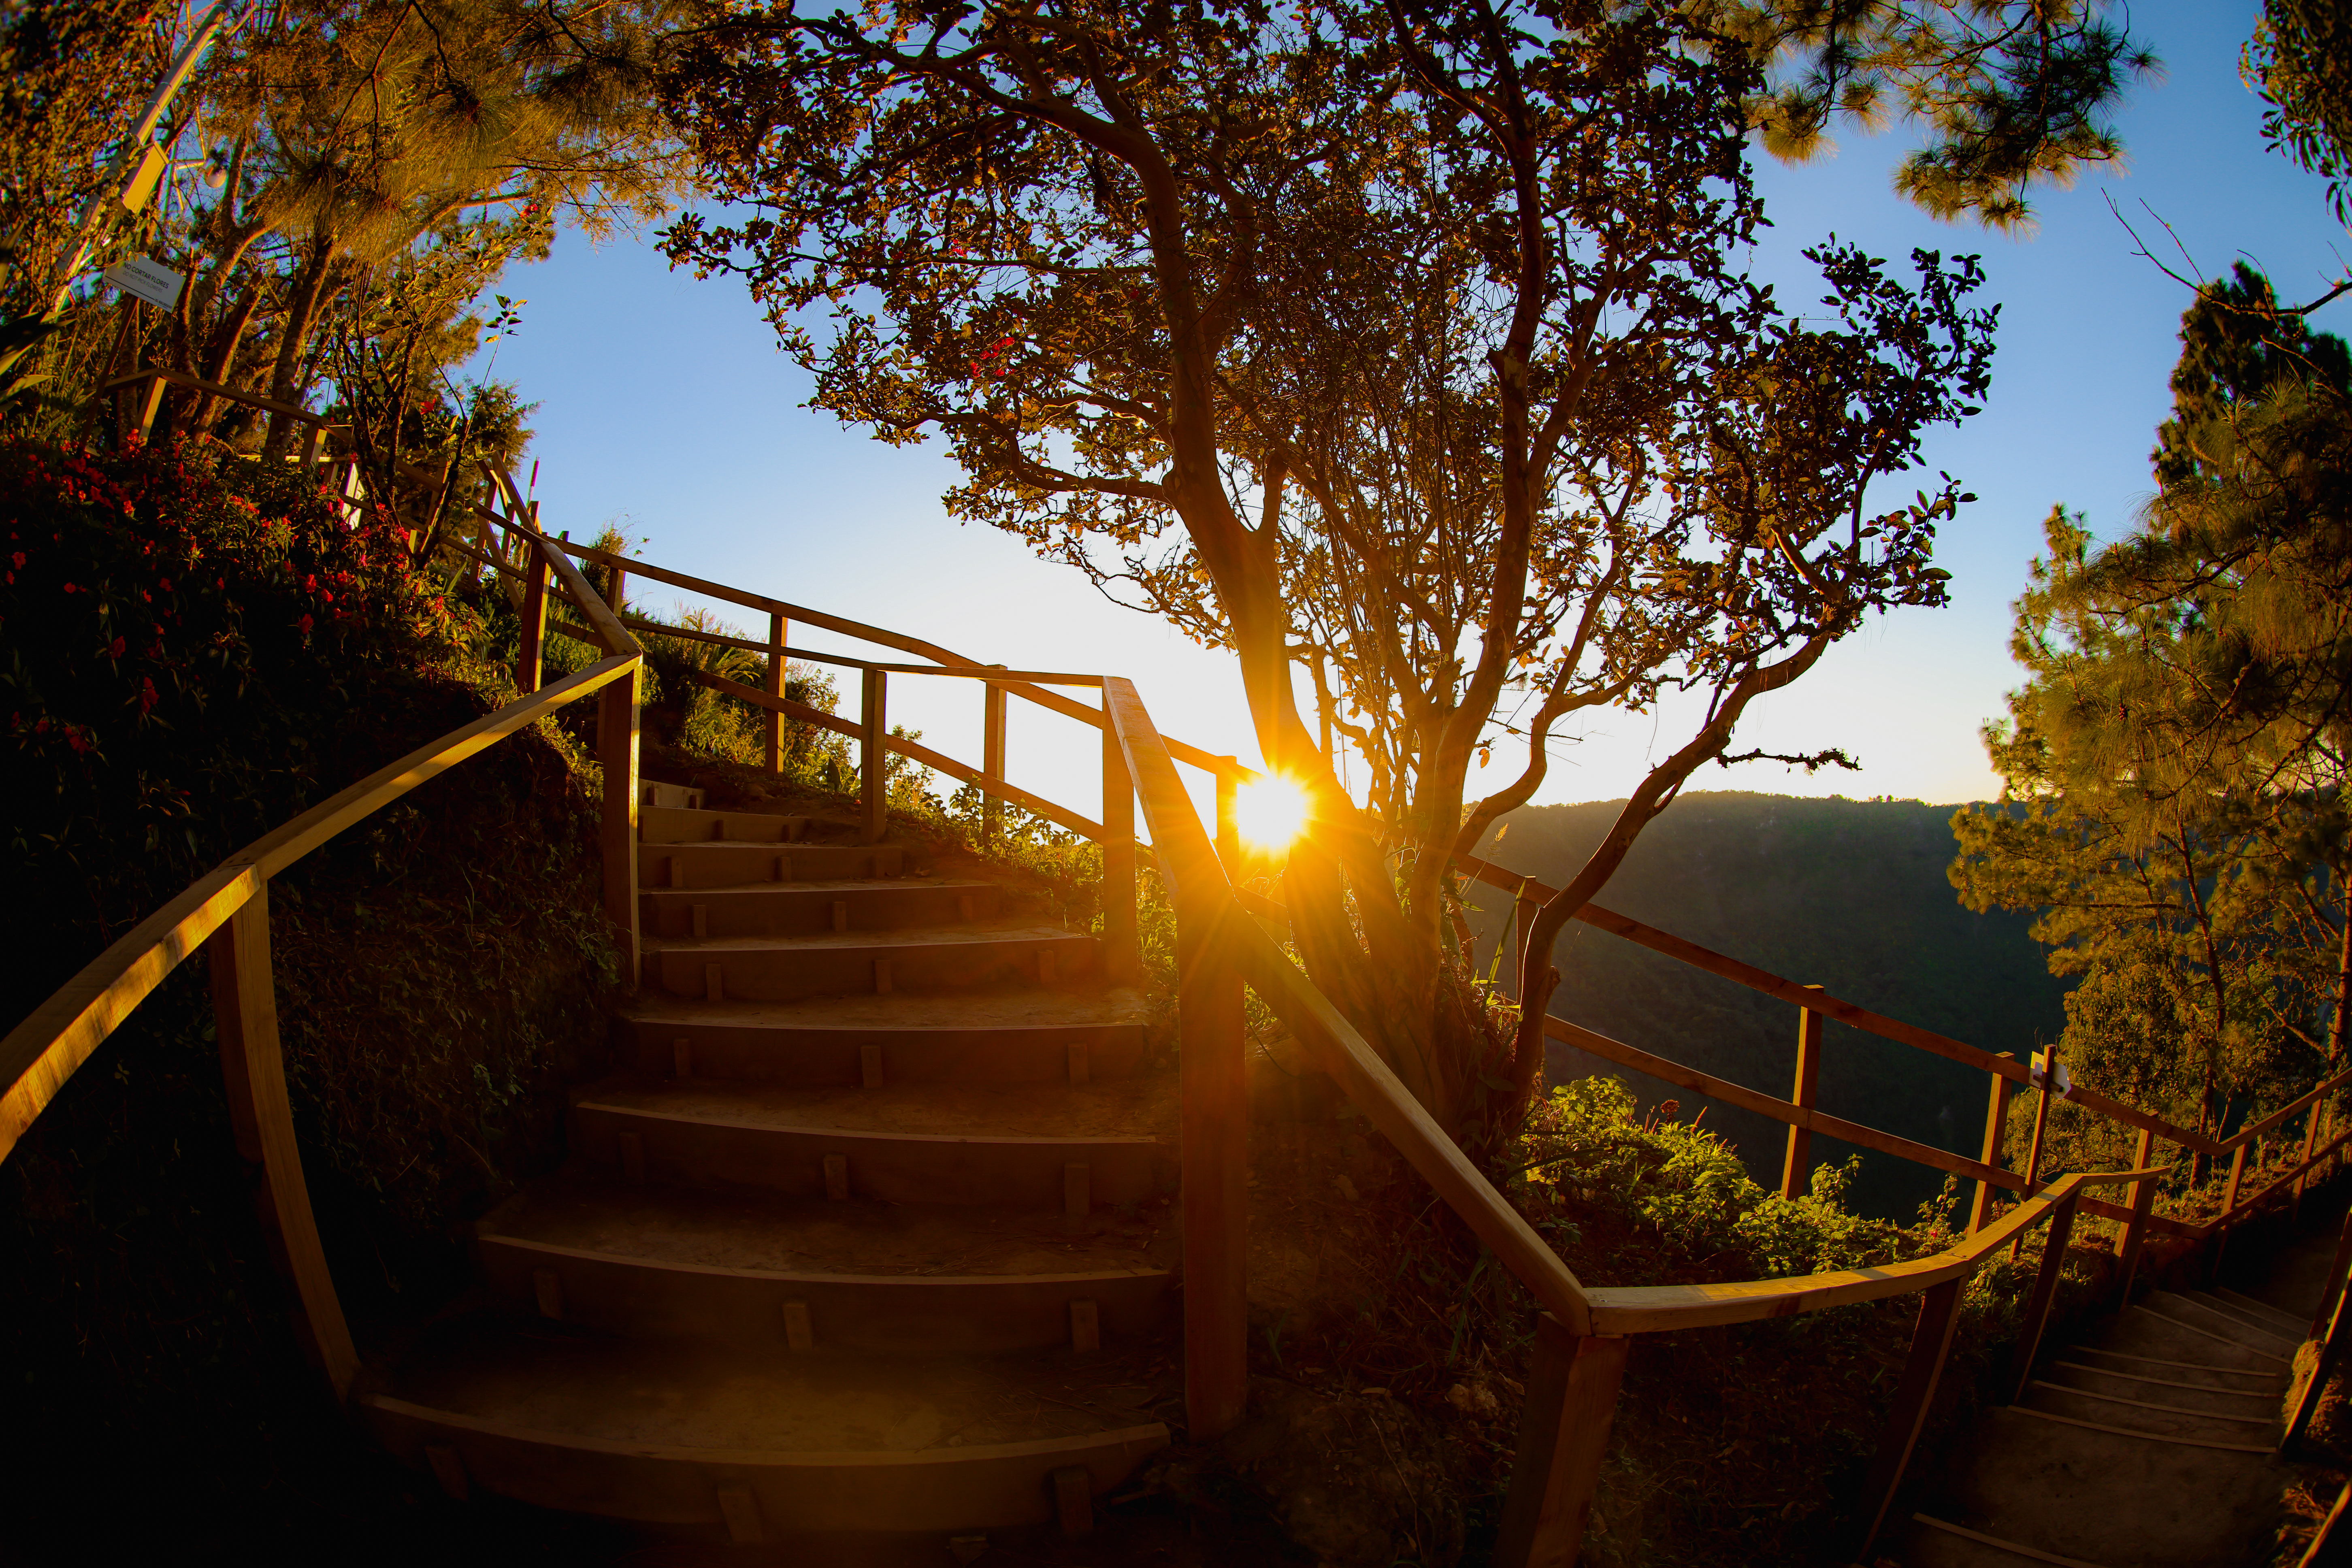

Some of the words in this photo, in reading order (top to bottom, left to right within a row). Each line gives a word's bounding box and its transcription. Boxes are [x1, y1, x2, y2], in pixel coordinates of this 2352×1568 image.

[132, 266, 151, 279] CORTAR
[151, 276, 169, 288] FLORES
[146, 282, 163, 292] FLOWERS
